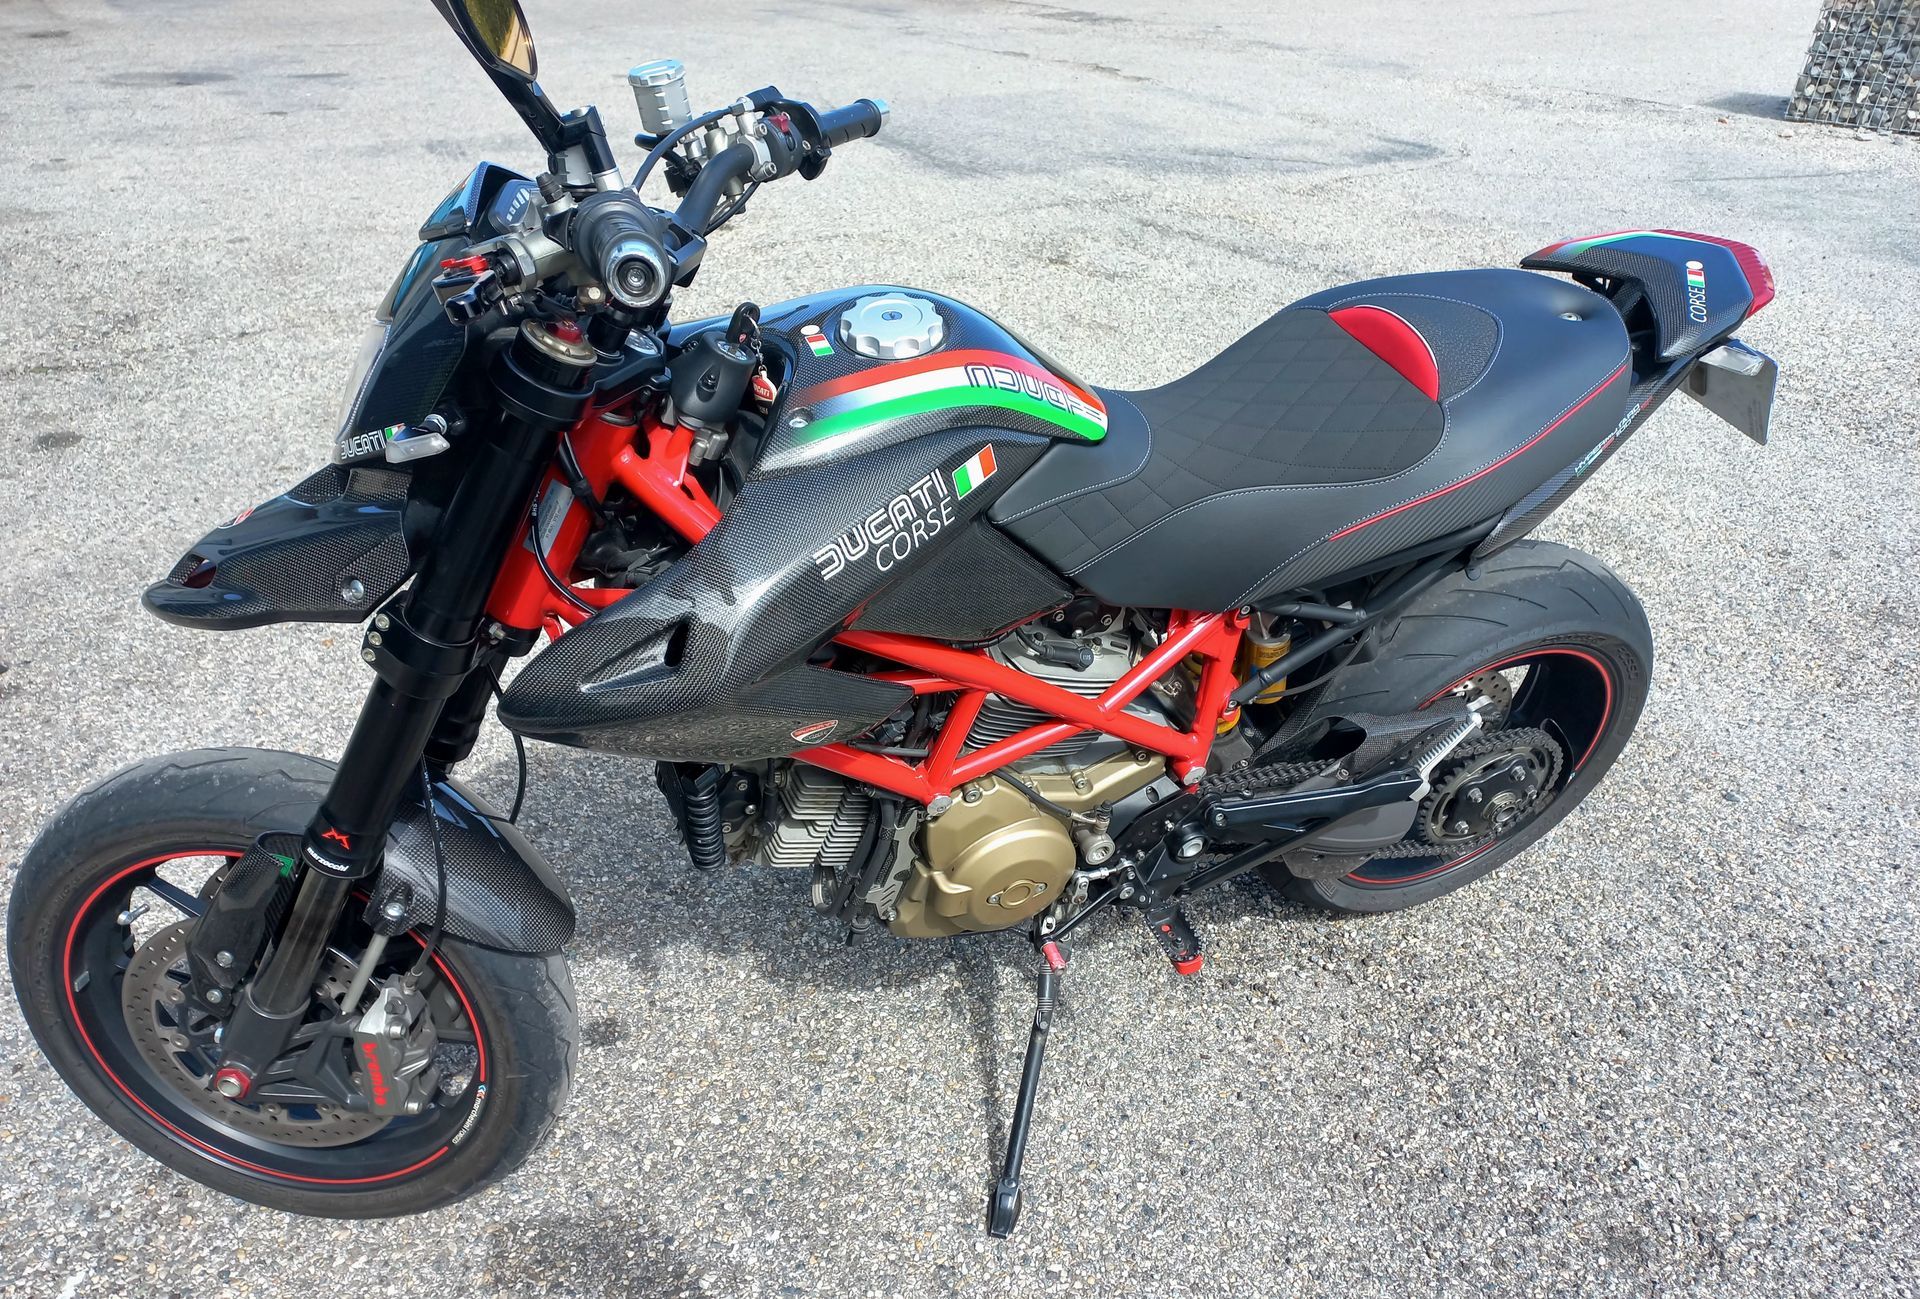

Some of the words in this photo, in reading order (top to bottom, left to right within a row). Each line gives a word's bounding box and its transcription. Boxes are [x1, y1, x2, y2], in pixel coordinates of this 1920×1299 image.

[1690, 287, 1707, 323] CORSE
[341, 430, 387, 460] DUCATI
[813, 468, 948, 581] DUCATI
[876, 497, 956, 572] CORSE
[306, 846, 350, 872] marzocchi
[362, 1042, 390, 1106] brembo
[463, 1097, 482, 1131] marchesini
